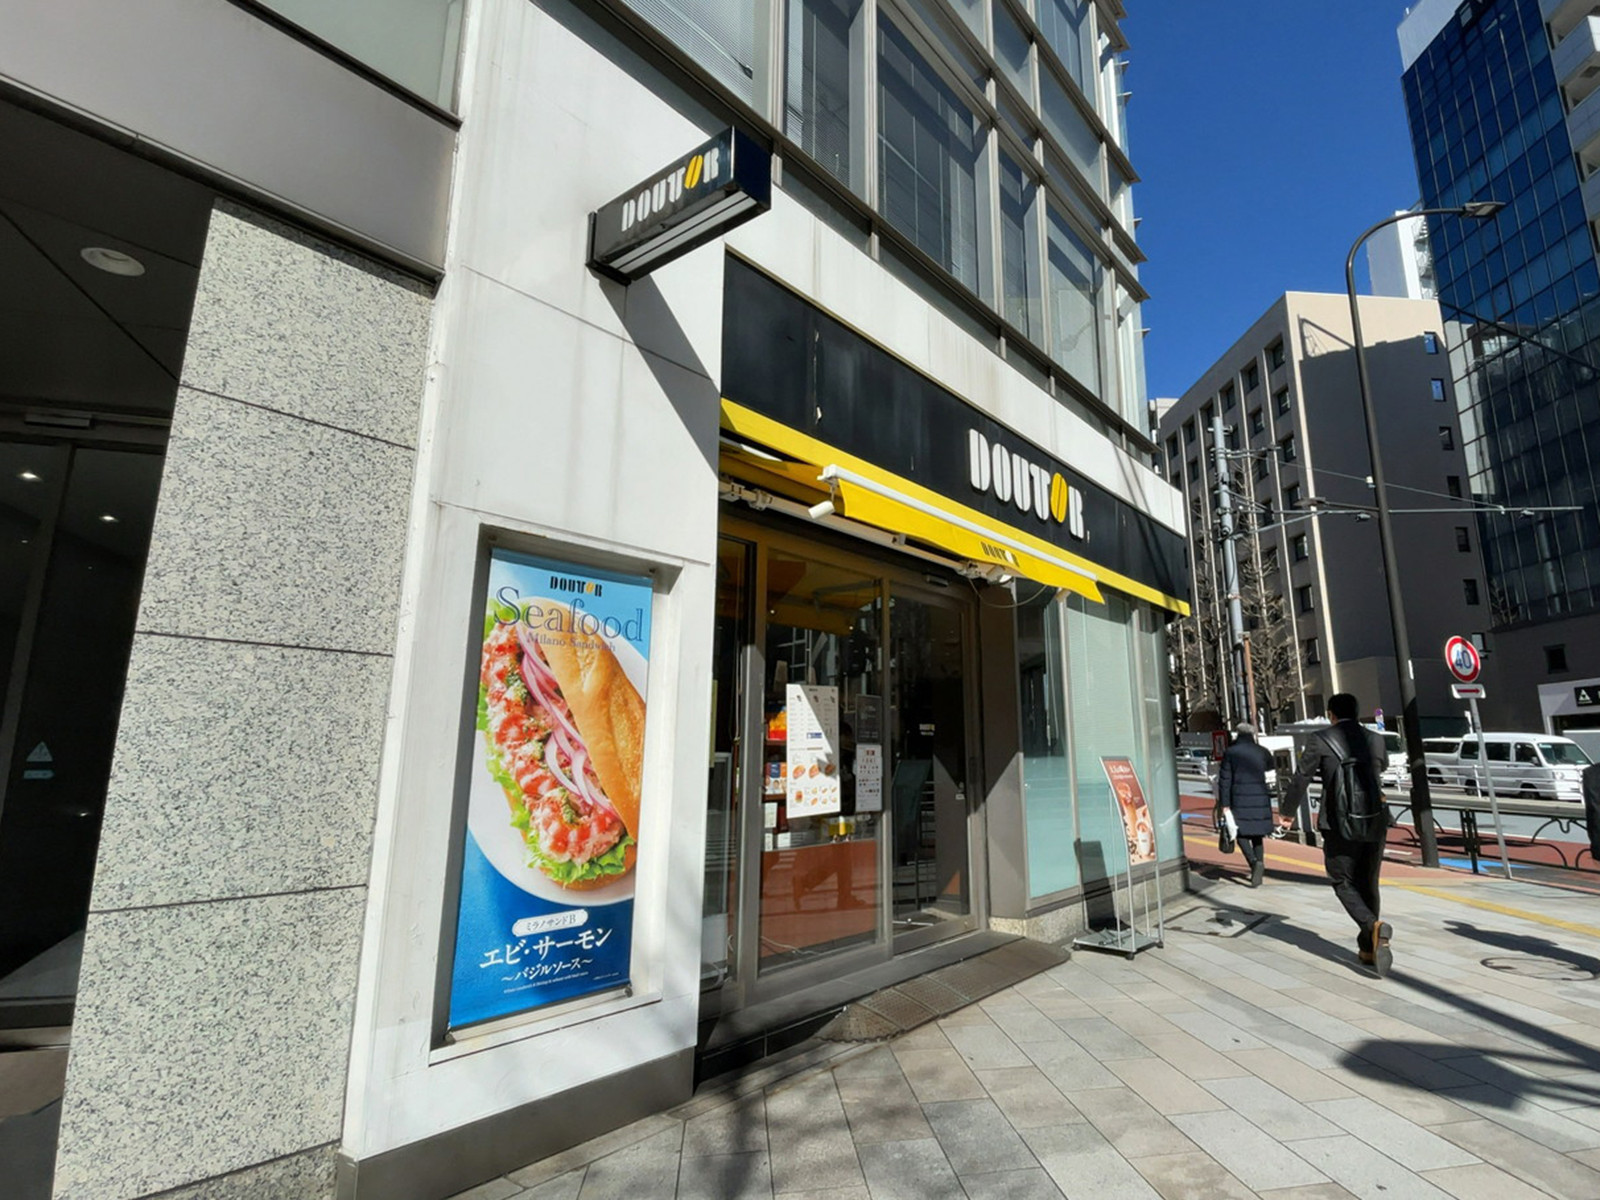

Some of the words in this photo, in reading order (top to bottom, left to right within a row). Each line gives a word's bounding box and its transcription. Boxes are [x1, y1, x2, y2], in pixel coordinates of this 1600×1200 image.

[622, 147, 719, 231] DOUTOR
[969, 429, 1084, 539] DOUTOR
[550, 576, 602, 596] DOUTOR
[494, 586, 643, 642] Seafood
[527, 632, 566, 646] Milano
[1455, 650, 1472, 669] 40
[479, 927, 612, 968] エビ・サーモン
